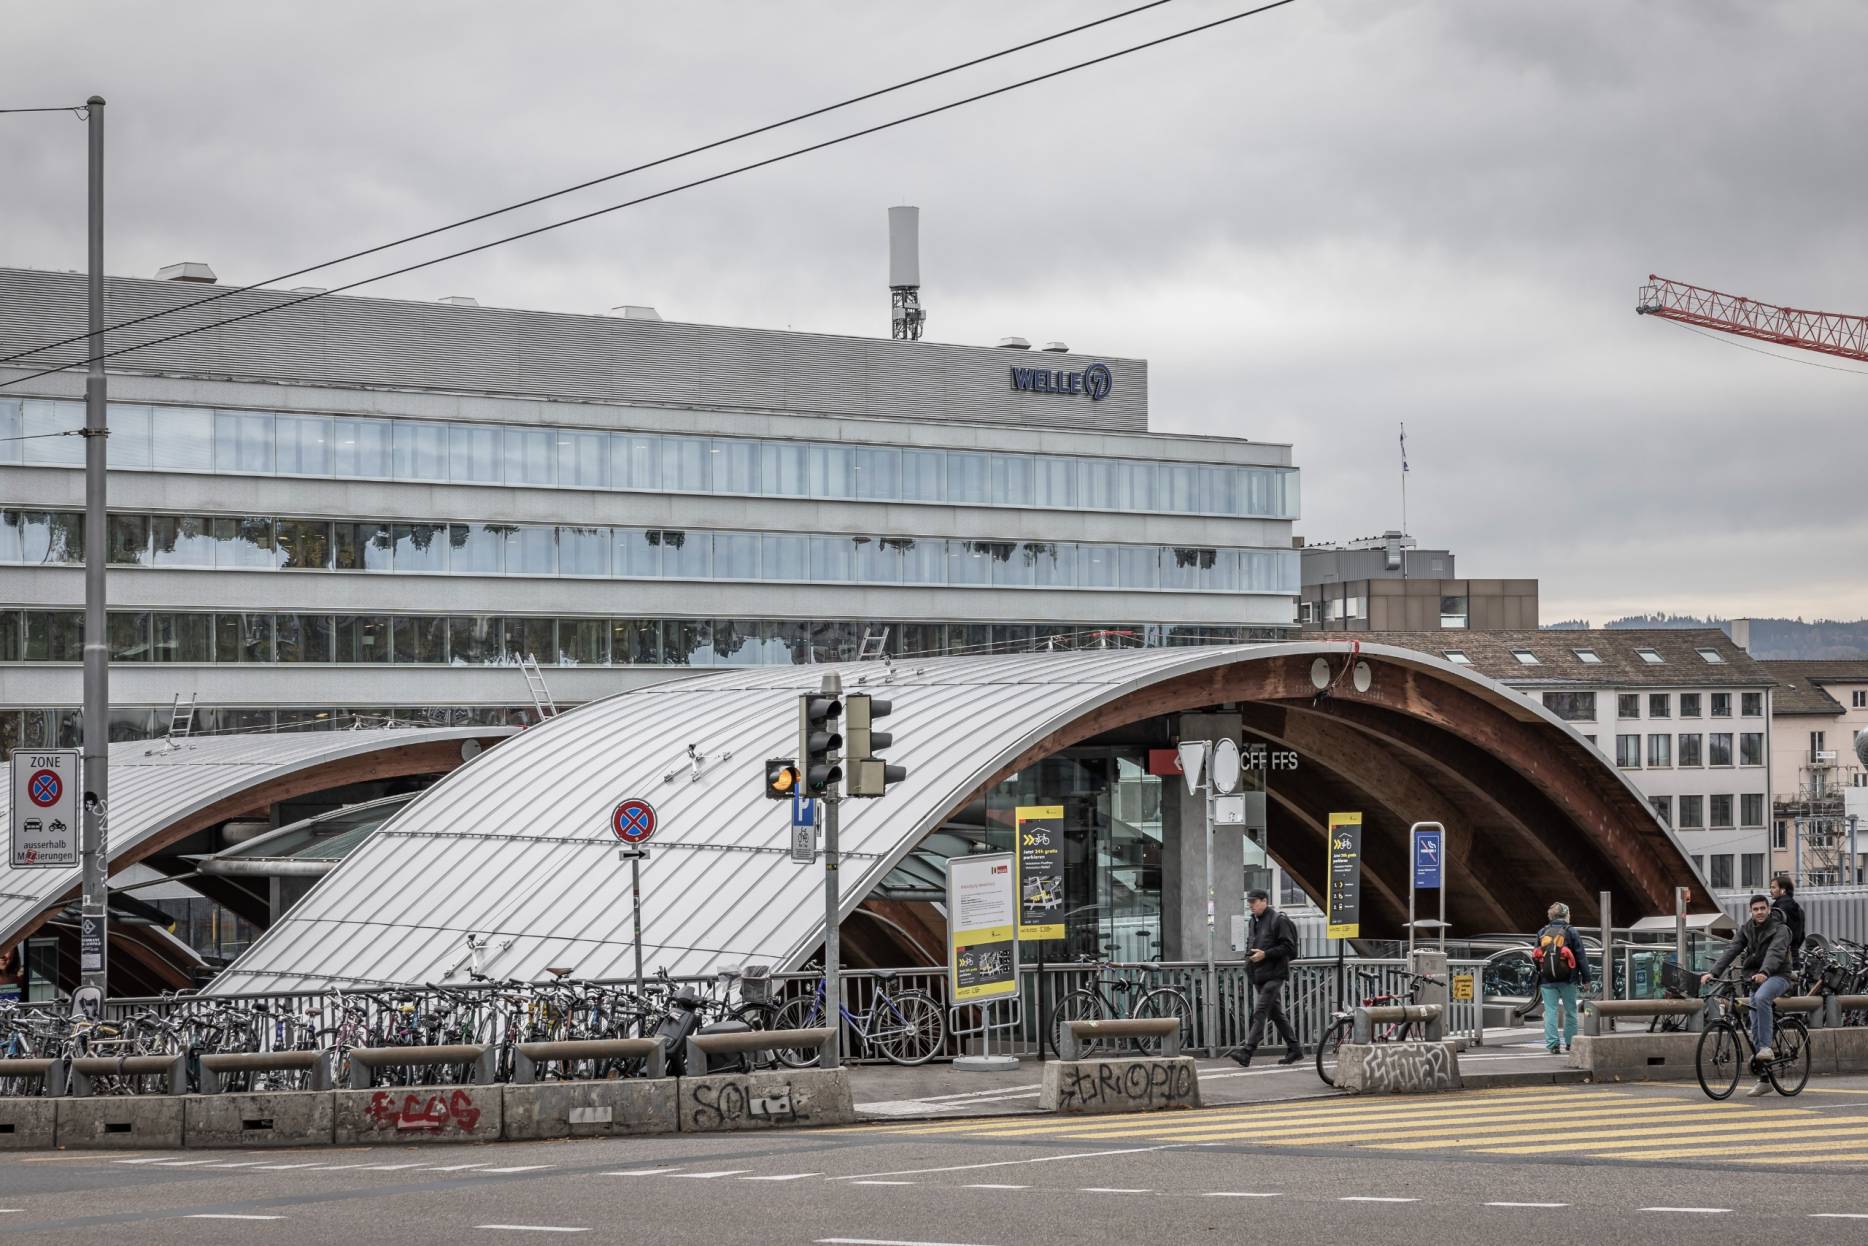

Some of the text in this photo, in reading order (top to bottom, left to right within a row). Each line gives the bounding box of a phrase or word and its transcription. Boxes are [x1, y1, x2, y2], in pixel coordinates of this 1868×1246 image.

[1012, 366, 1083, 394] WELLE
[30, 756, 61, 768] ZONE
[1241, 751, 1299, 770] CFF FFS
[798, 795, 810, 822] P
[23, 839, 67, 849] ausserhalb
[16, 851, 73, 861] Mierungen
